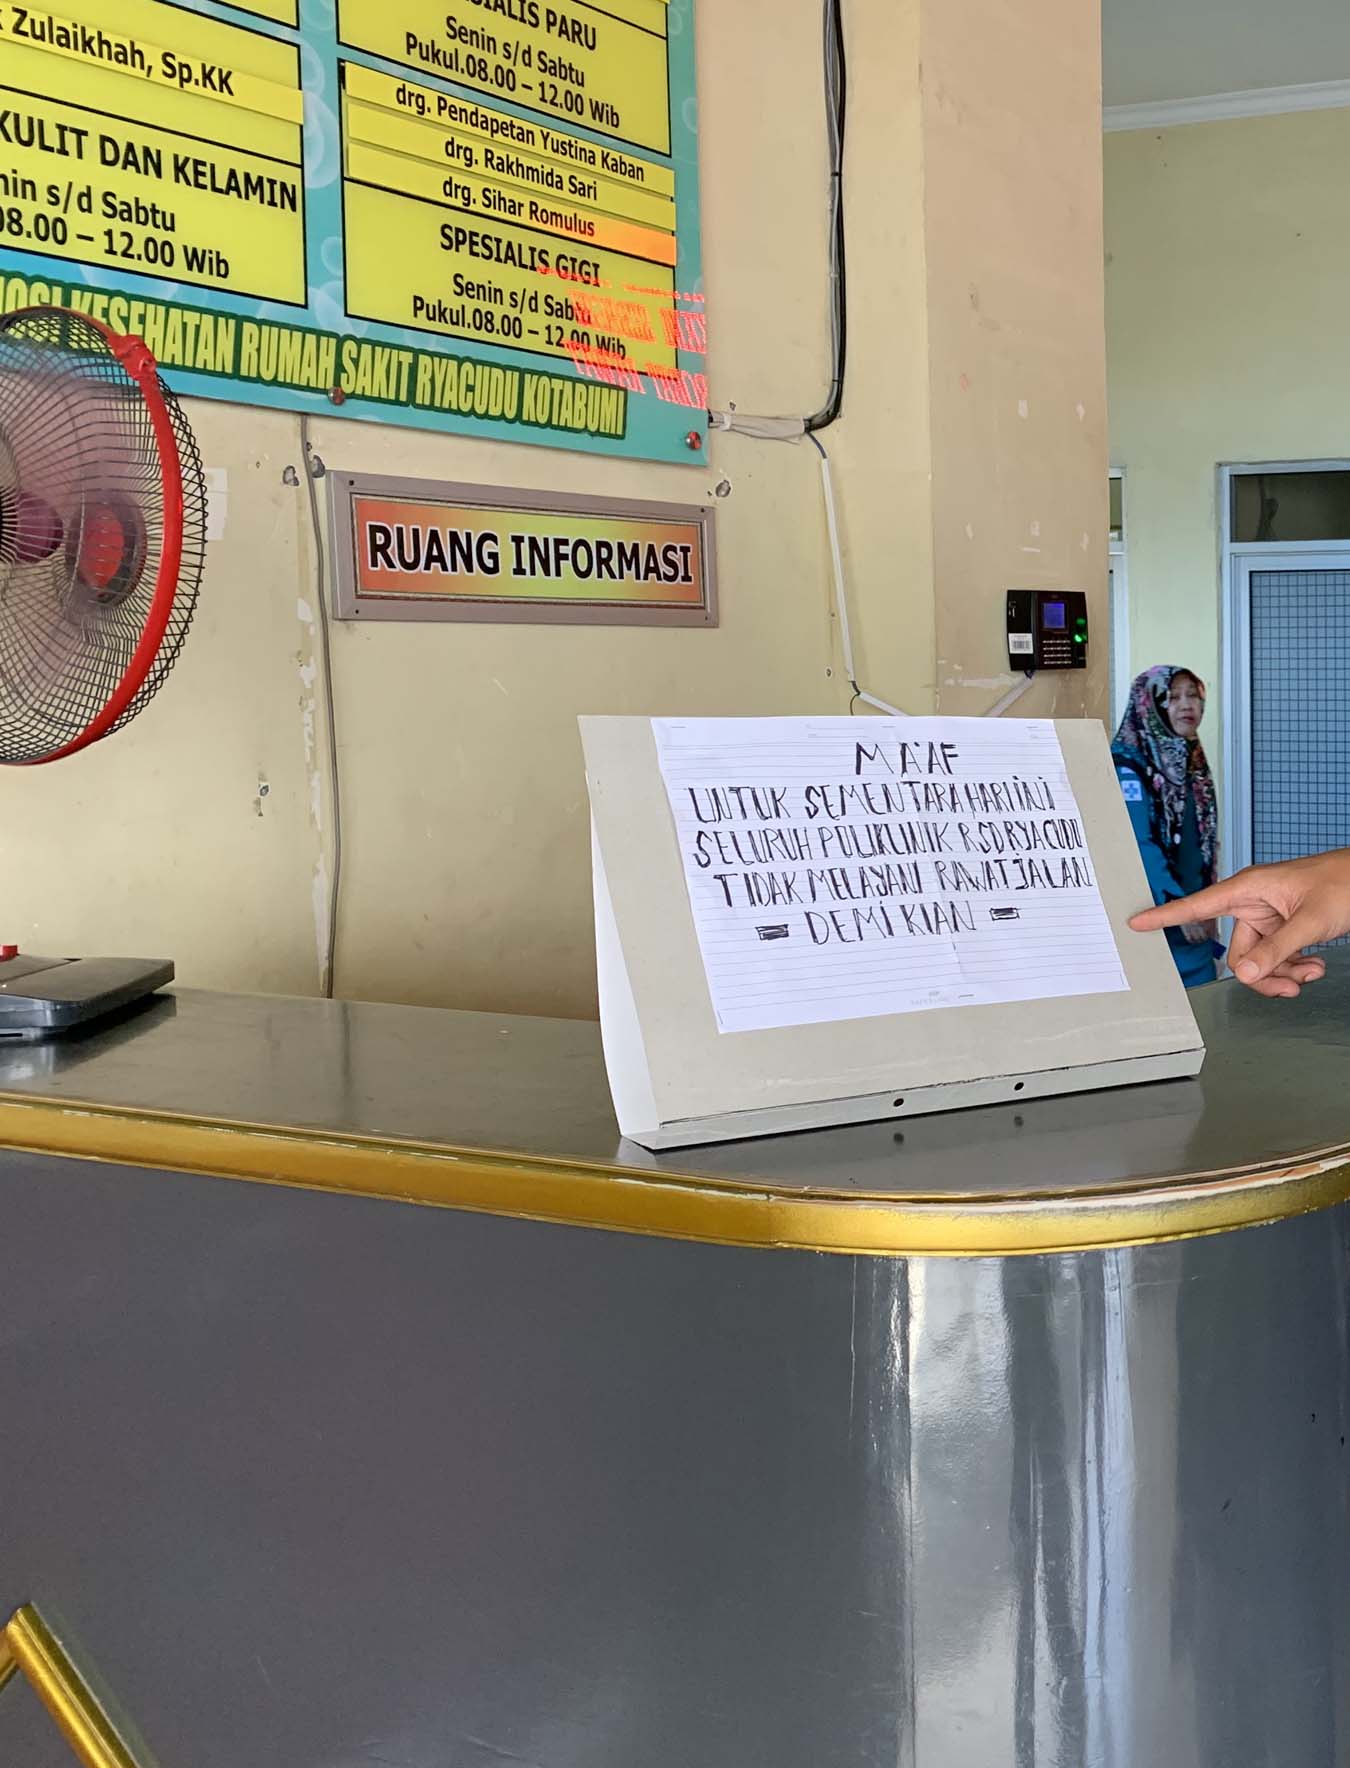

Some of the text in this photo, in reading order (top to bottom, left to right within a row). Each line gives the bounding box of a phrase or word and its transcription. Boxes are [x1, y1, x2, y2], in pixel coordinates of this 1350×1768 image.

[11, 7, 235, 97] Zulaikhah, Sp.KK
[446, 15, 585, 88] Senin s/d Sabtu
[546, 8, 597, 51] PARU
[405, 32, 517, 93] Pukul.08.00
[538, 81, 584, 116] 12.00
[589, 97, 620, 129] Wib
[395, 84, 645, 183] drg. Pendapetan Yustina Kaban
[99, 134, 163, 180] DAN
[173, 153, 298, 213] KELAMIN
[444, 137, 598, 201] drg. Rakhmida Sari
[46, 182, 93, 214] s/d
[102, 191, 175, 233] Sabtu
[442, 177, 596, 238] drg. Sihar Romulus
[103, 228, 175, 268] 12.00
[183, 244, 230, 279] Wib
[440, 223, 601, 288] SPESIALIS GIGI
[453, 273, 504, 306] Senin
[509, 288, 539, 315] s/d
[413, 295, 523, 340] Pukul.08.00
[595, 334, 627, 361] Wib
[242, 322, 337, 391] RUMAH
[341, 341, 413, 402] SAKIT
[415, 353, 519, 421] RYACUDU
[523, 372, 626, 436] KOTABUMI
[367, 522, 694, 584] RUANG INFORMASI
[688, 785, 789, 824] UNTUK
[805, 779, 961, 821] SEMENTARA
[692, 828, 810, 869] SELURUH
[821, 821, 953, 860] POLIKLINIK
[713, 871, 808, 908] TIDAK
[808, 859, 924, 906] MELAYANI
